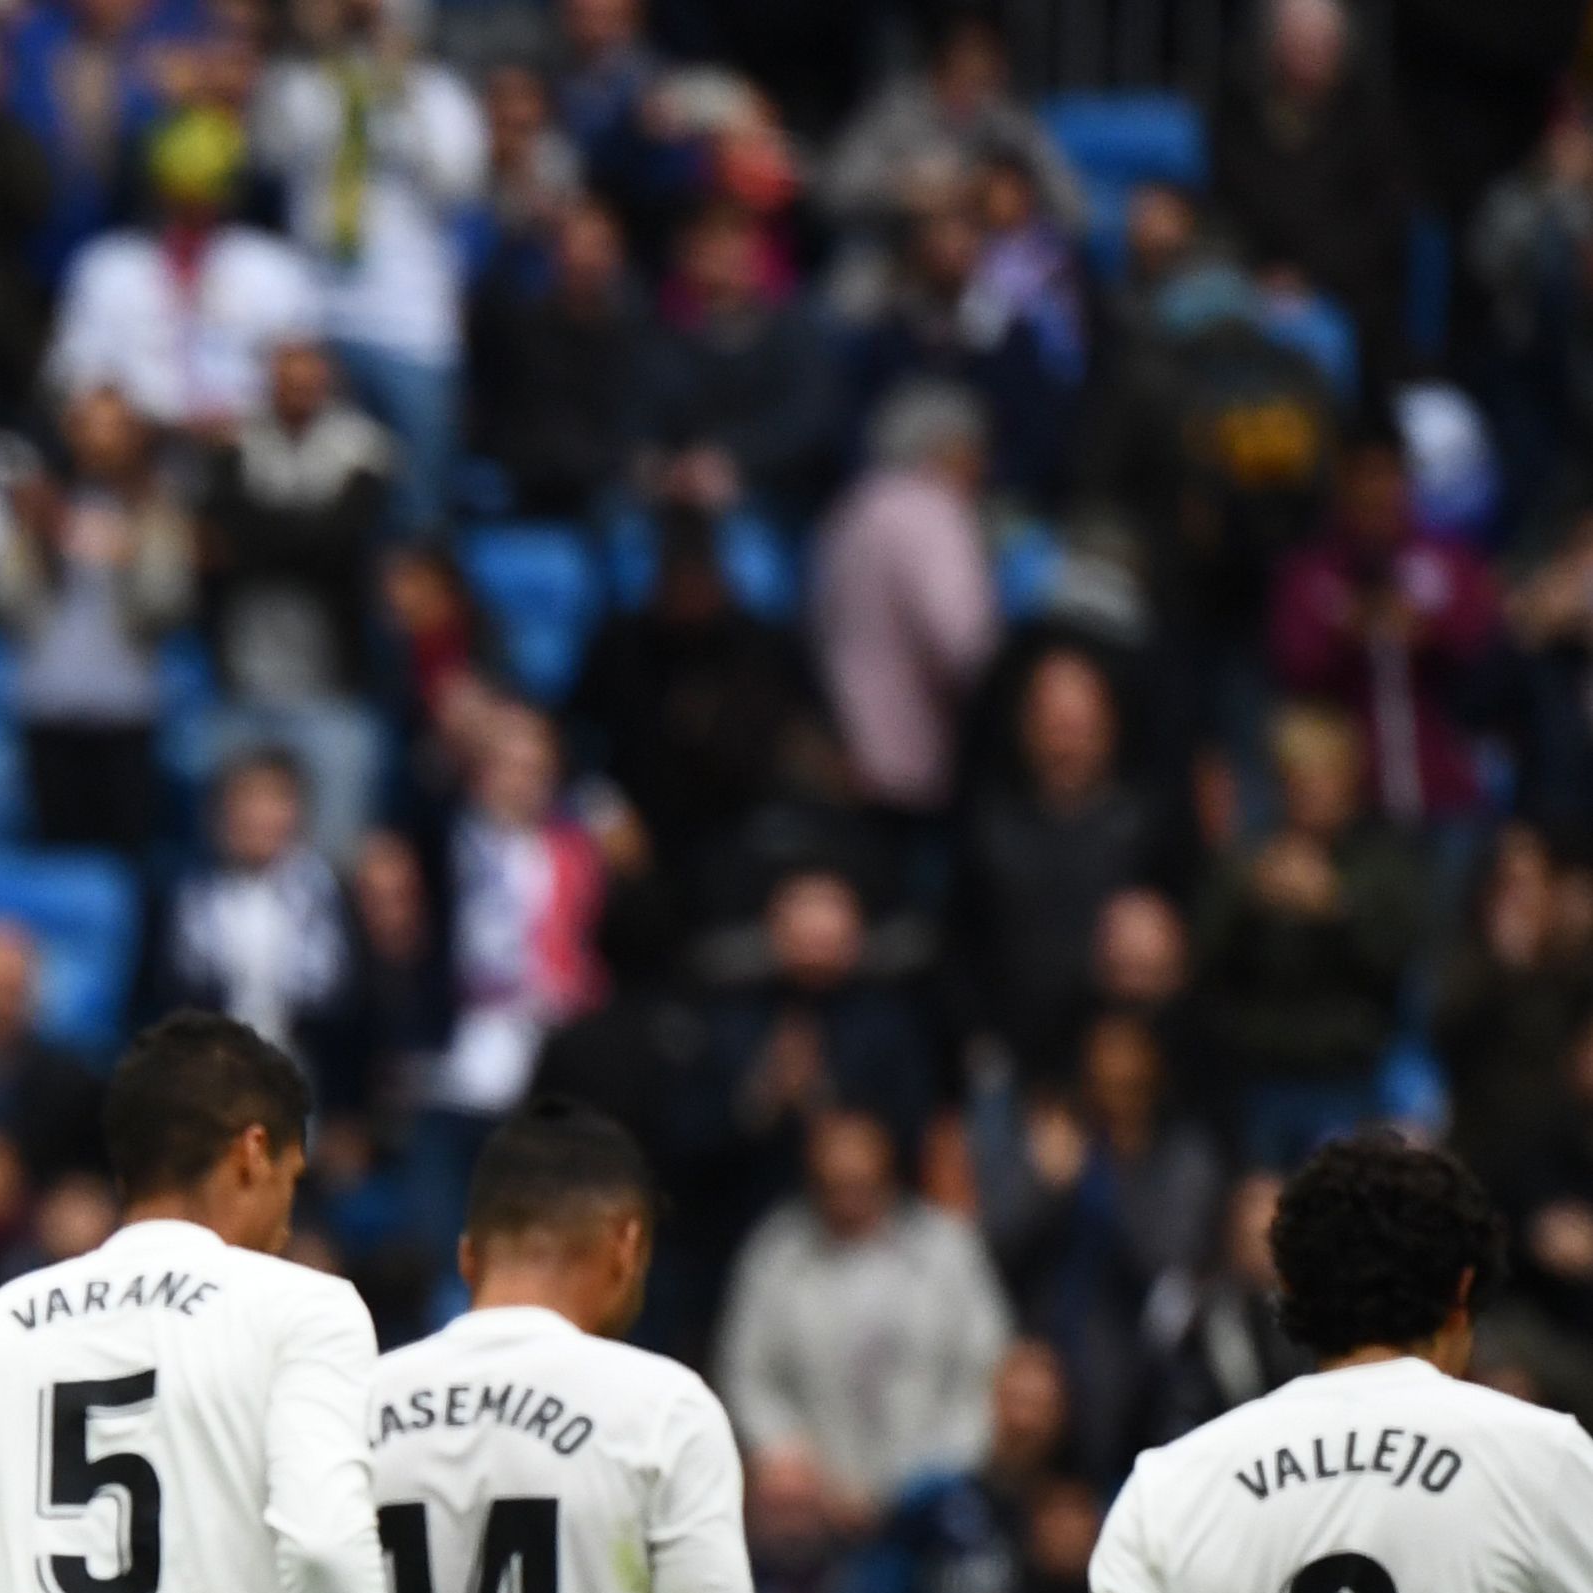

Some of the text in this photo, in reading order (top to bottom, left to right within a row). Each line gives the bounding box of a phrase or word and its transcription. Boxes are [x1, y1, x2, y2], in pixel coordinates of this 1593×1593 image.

[10, 1271, 219, 1330] VARANE
[367, 1385, 594, 1456] ASEMIRO
[1235, 1427, 1464, 1501] VALLEJO
